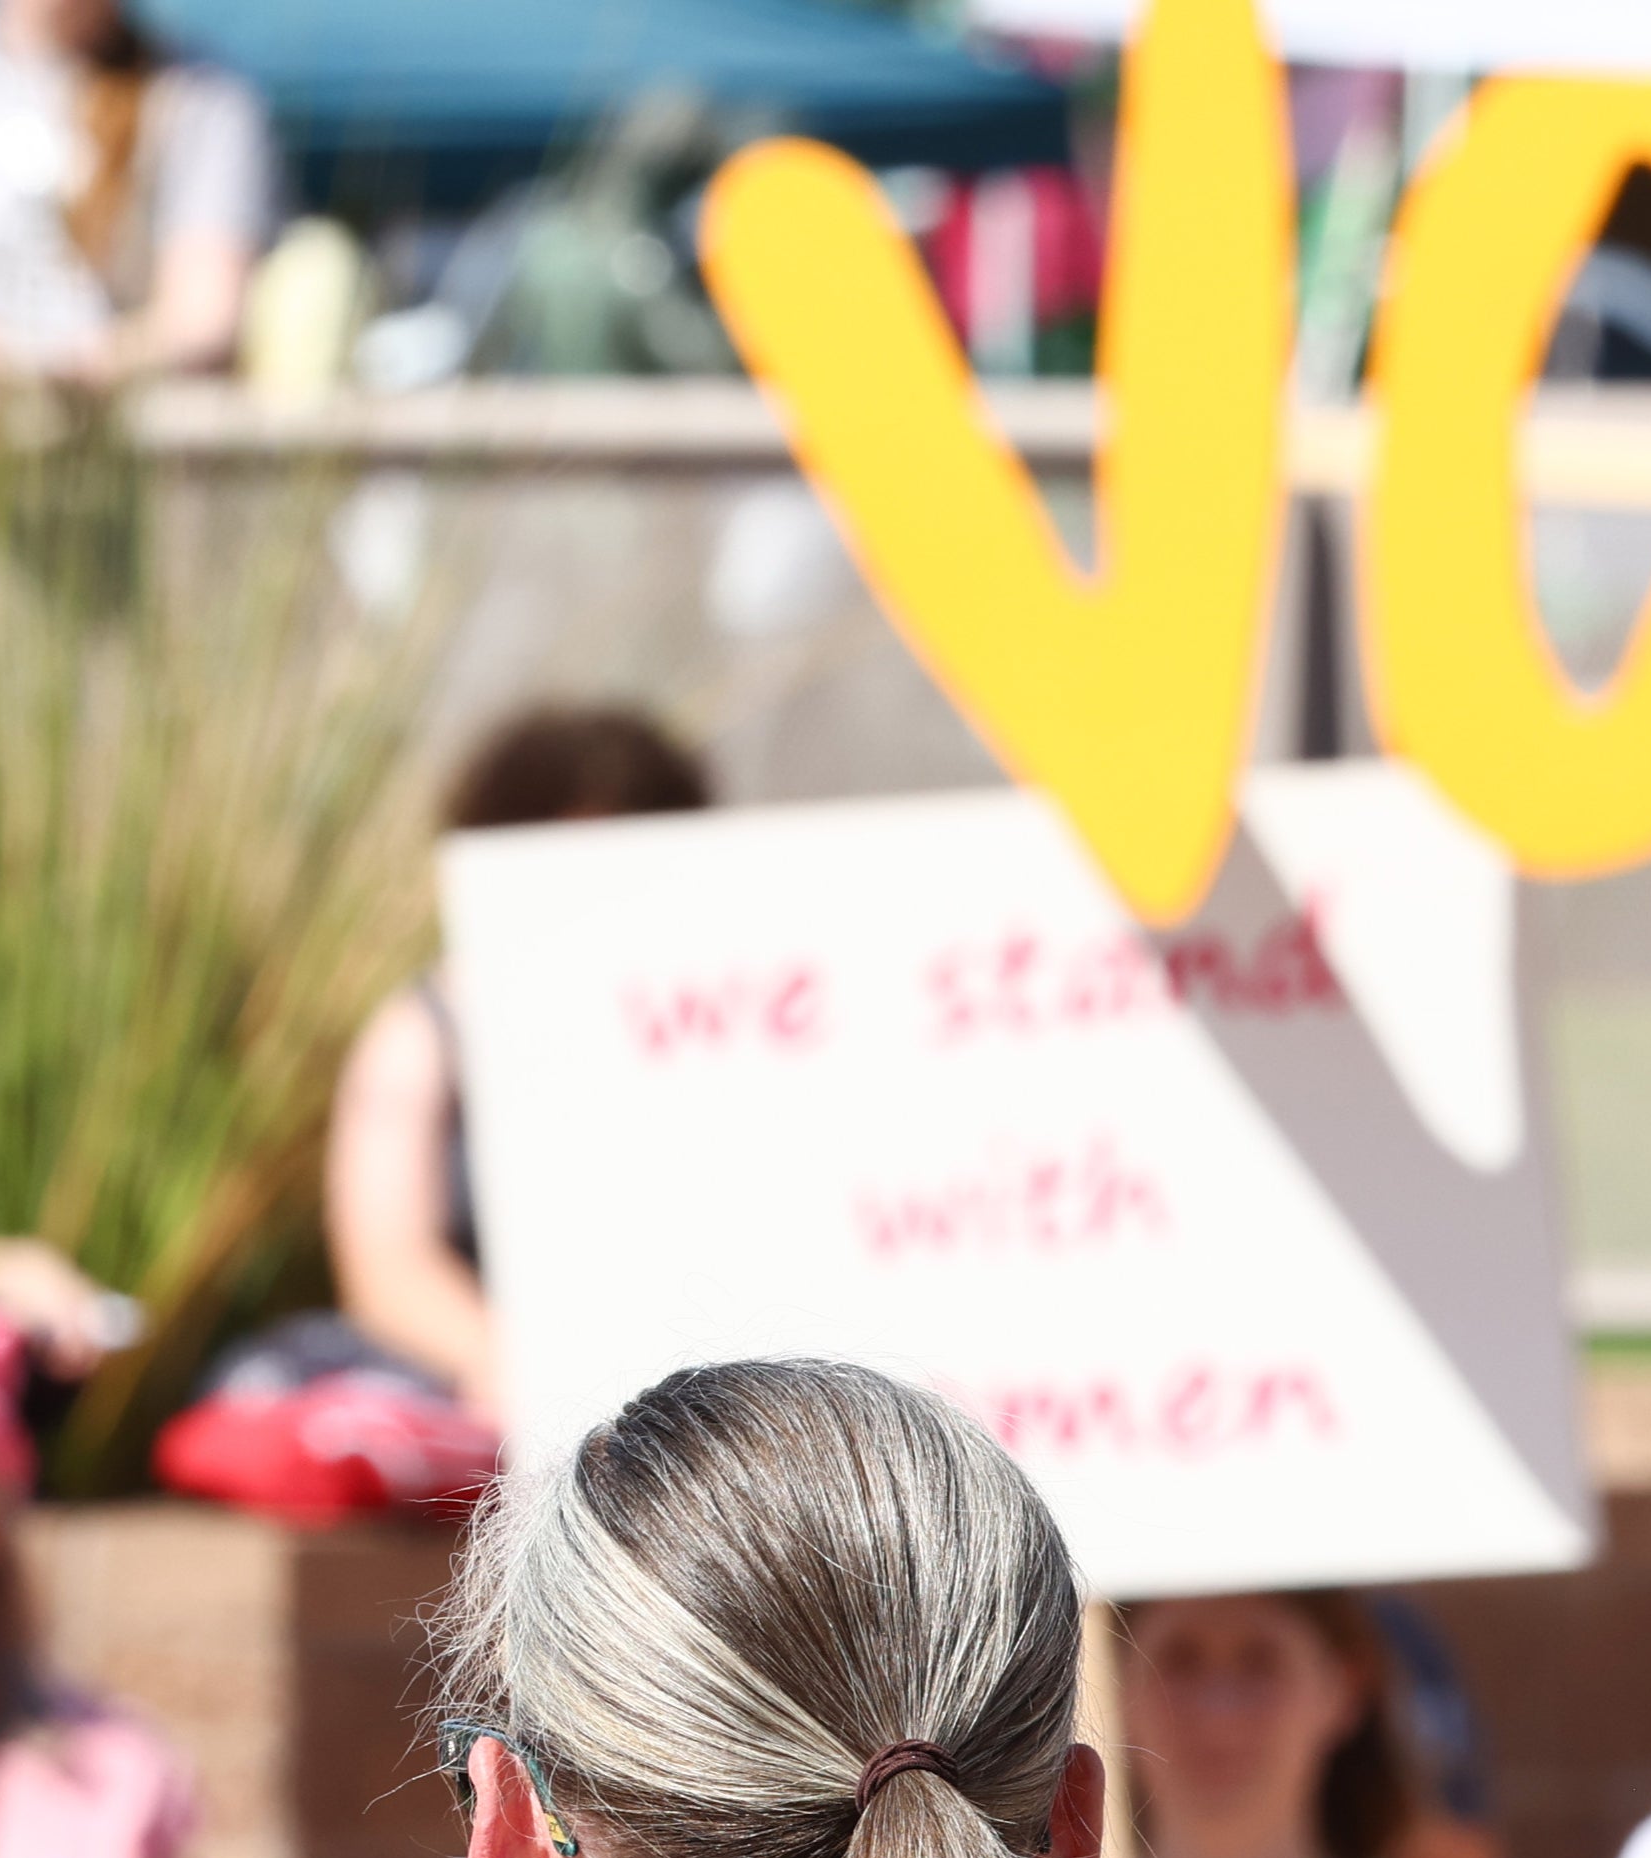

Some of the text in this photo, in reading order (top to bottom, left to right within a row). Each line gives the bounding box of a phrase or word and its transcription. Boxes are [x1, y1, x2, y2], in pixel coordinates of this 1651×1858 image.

[624, 890, 1347, 1058] we stand
[852, 1128, 1176, 1262] with
[934, 1362, 1344, 1462] men
